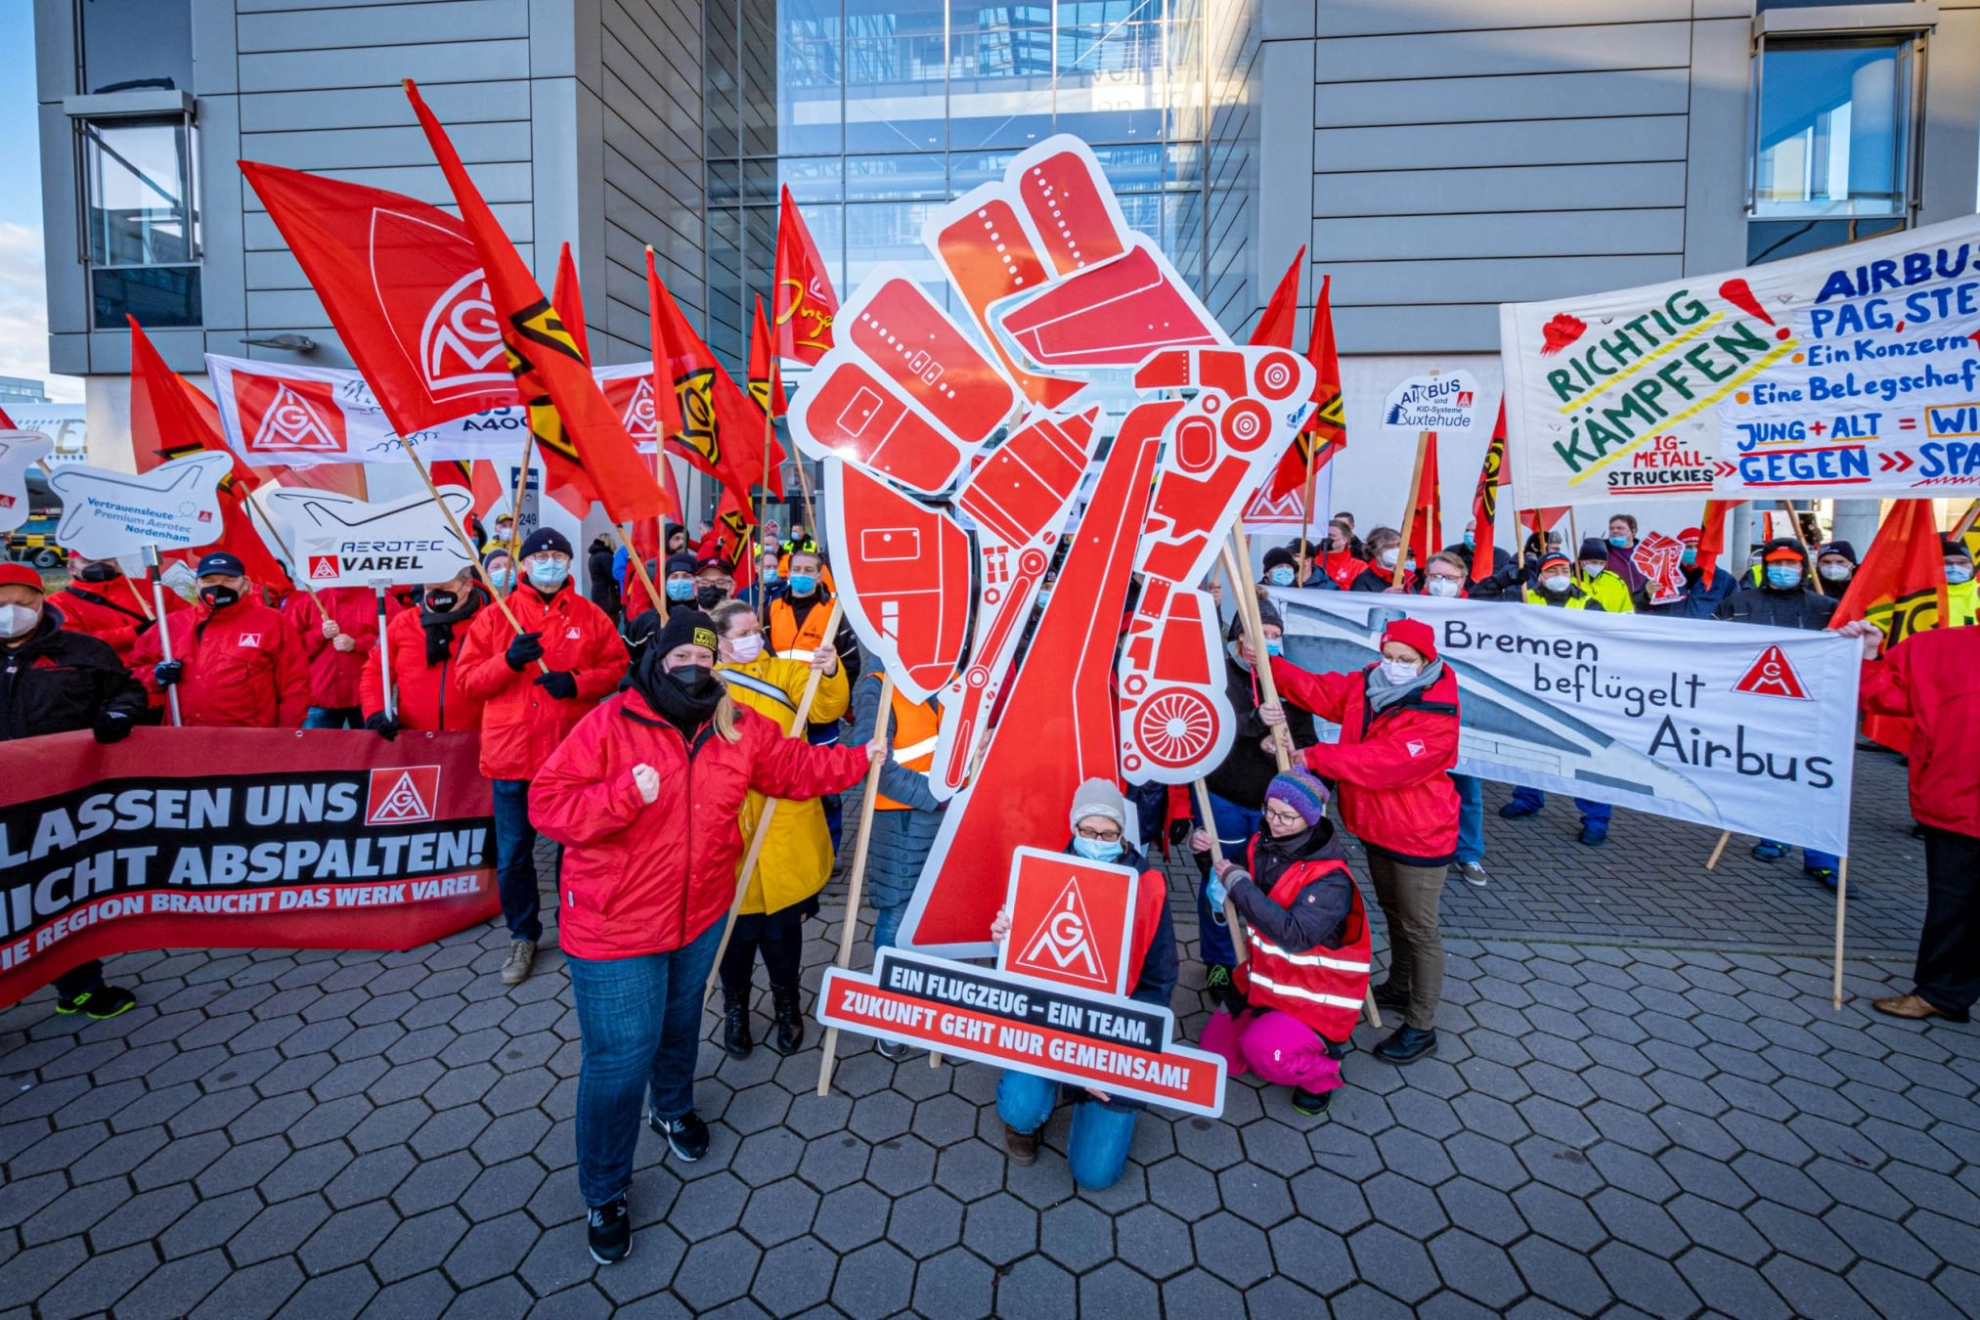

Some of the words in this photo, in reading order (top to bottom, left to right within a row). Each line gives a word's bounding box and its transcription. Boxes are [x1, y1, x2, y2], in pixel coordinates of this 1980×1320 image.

[1814, 244, 1980, 304] AIRBU
[1547, 289, 1710, 402] RICHTIG
[1808, 345, 1850, 366] Ein
[1854, 336, 1968, 361] Konzern
[1401, 379, 1460, 405] AIRBUS
[1753, 382, 1803, 405] Eine
[1388, 403, 1471, 427] Buxtehude
[1736, 421, 1806, 451] JUNG
[1831, 413, 1882, 438] ALT
[1607, 469, 1714, 486] STRUCKIES
[1633, 451, 1712, 469] METALL-
[1739, 447, 1870, 483] GEGEN
[87, 496, 174, 521] Vertrauensleute
[93, 509, 145, 526] Premium
[146, 519, 193, 534] Aerotec
[125, 524, 191, 543] Nordenham
[341, 540, 444, 553] AEROTEC
[342, 555, 424, 571] VAREL
[1444, 620, 1598, 661] Bremen
[1534, 662, 1706, 718] beflügelt
[1648, 713, 1834, 789] Airbus
[0, 788, 231, 869] LASSEN
[245, 782, 359, 826] UNS
[168, 828, 487, 885] ABSPALTEN!
[0, 938, 30, 970] IE
[36, 895, 144, 952] REGION
[151, 891, 275, 913] BRAUCHT
[279, 887, 330, 910] DAS
[335, 882, 404, 907] WERK
[411, 875, 480, 900] VAREL
[890, 966, 925, 993] EIN
[926, 975, 1028, 1017] FLUGZEUG
[1047, 1003, 1083, 1030] EIN
[1086, 1011, 1152, 1046] TEAM.
[841, 990, 938, 1031] ZUKUNFT
[940, 1013, 996, 1044] GEHT
[998, 1027, 1043, 1056] NUR
[1048, 1038, 1190, 1092] GEMEINSAM!
